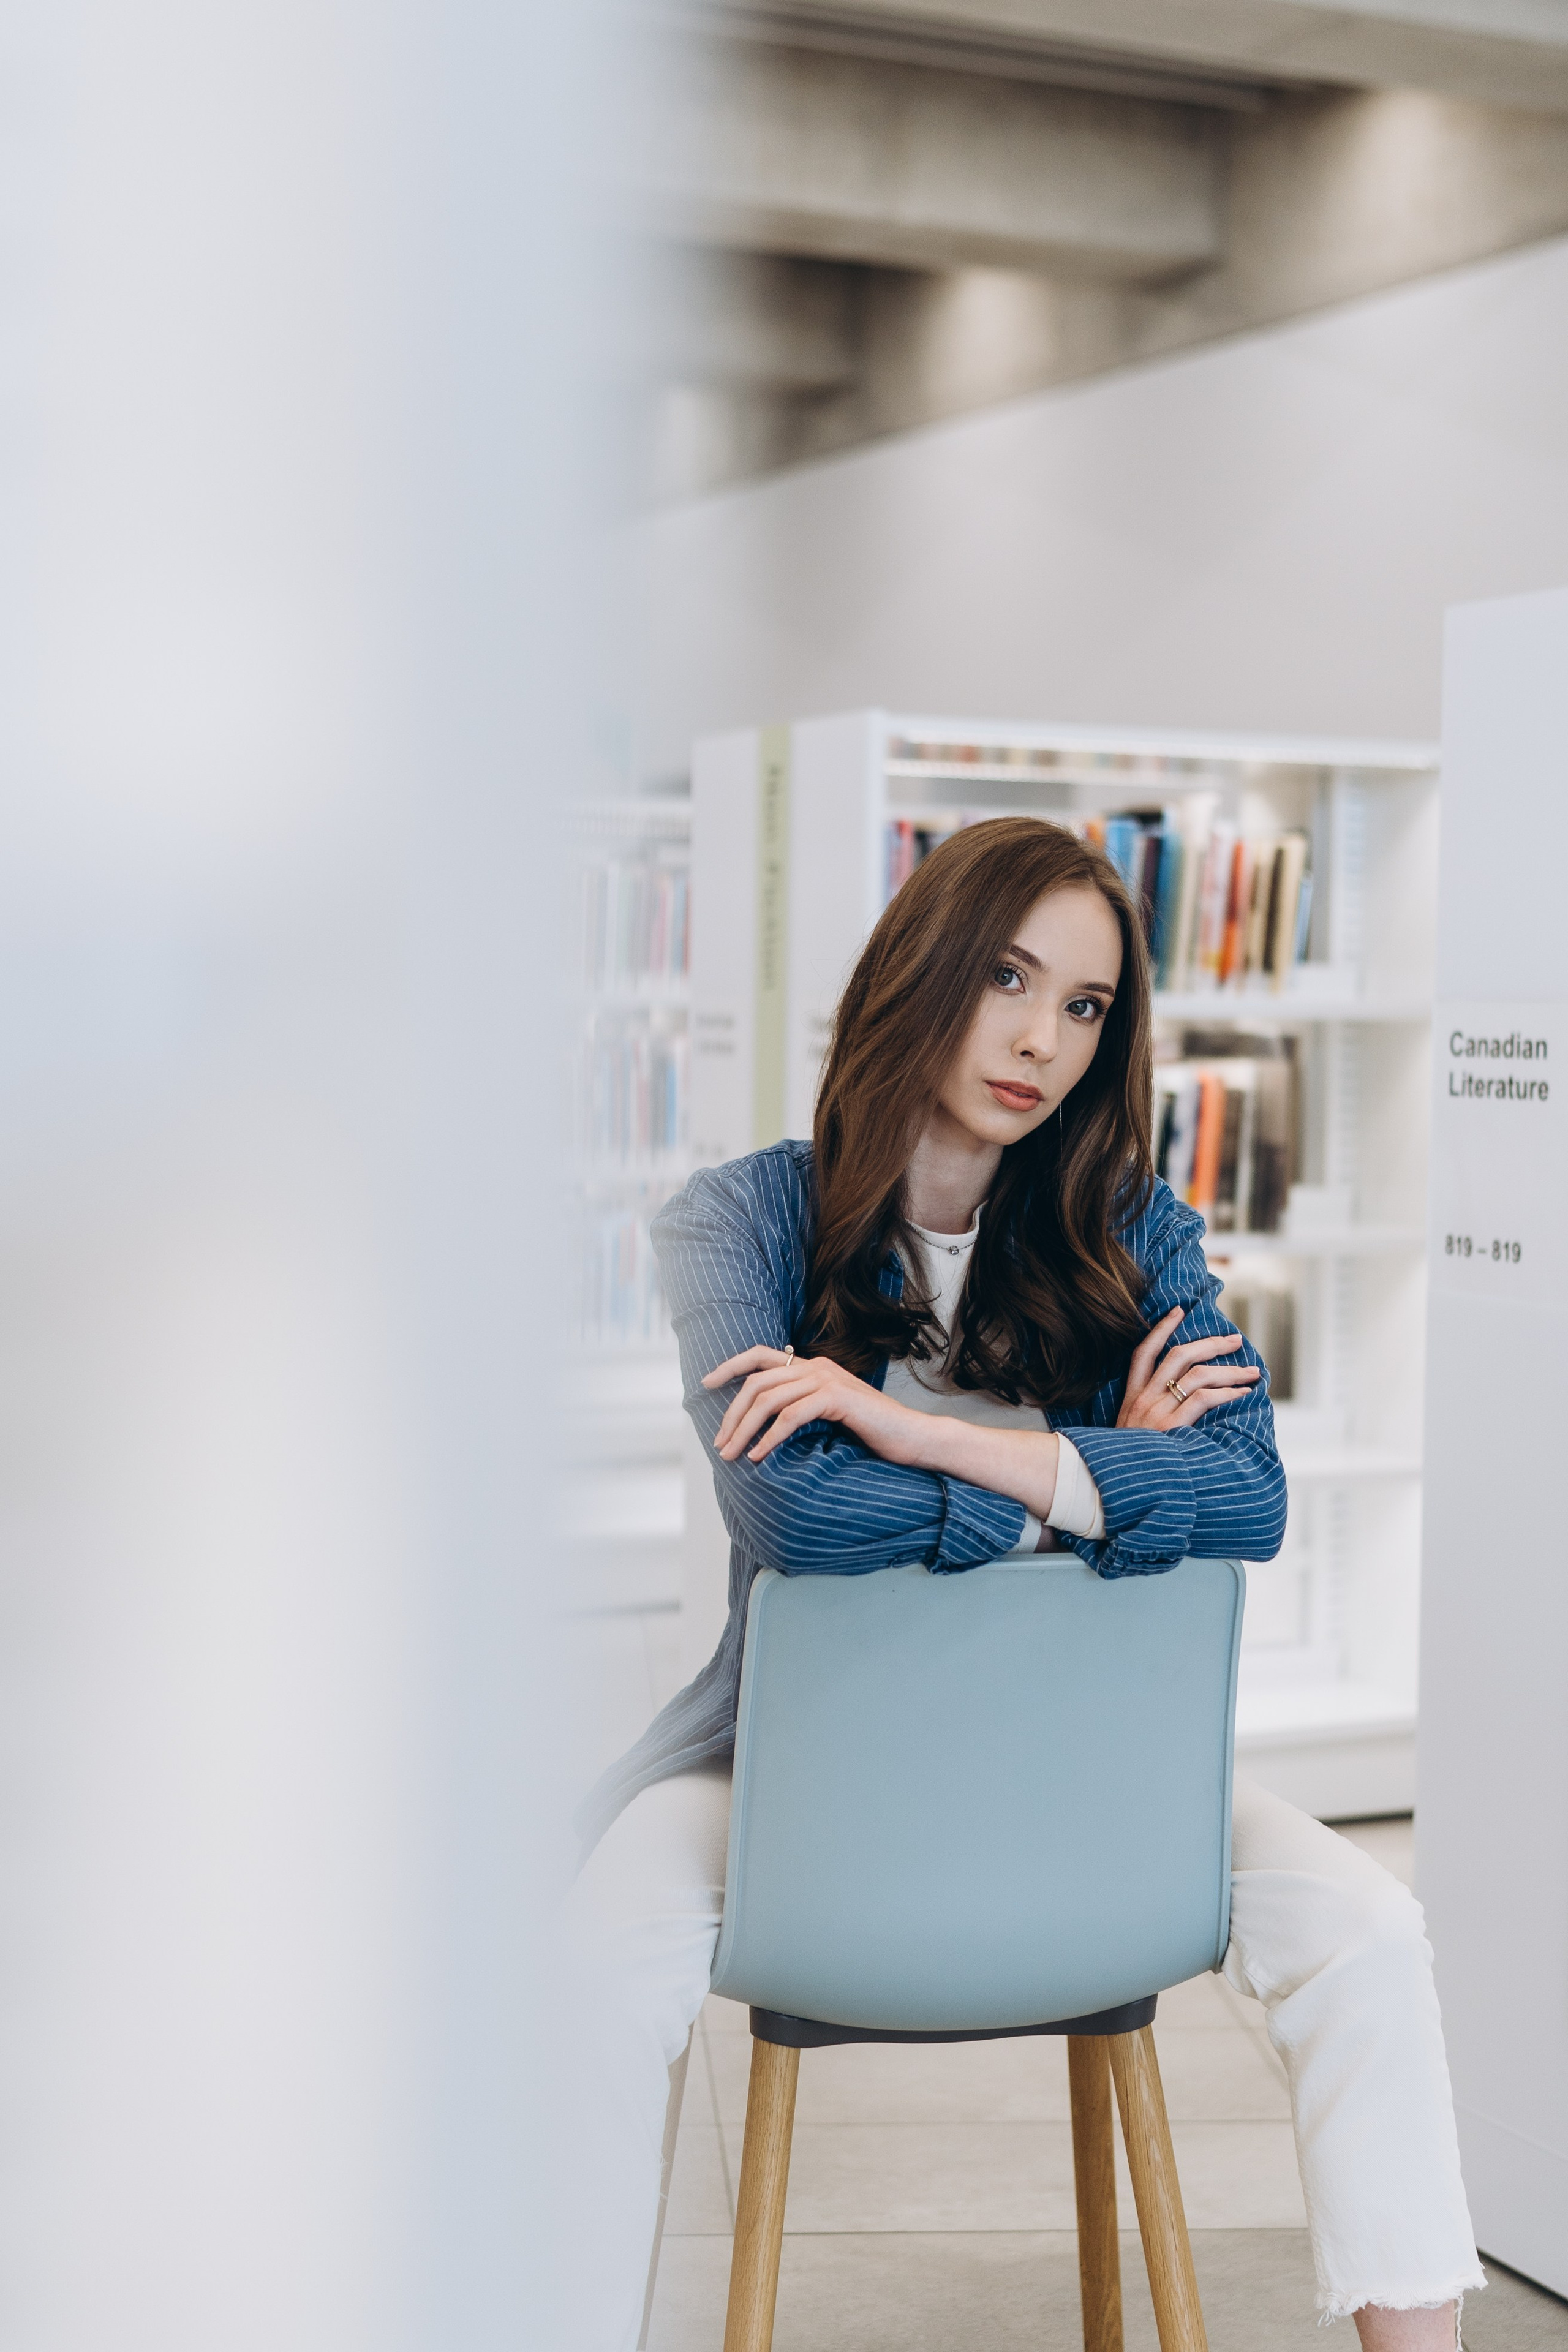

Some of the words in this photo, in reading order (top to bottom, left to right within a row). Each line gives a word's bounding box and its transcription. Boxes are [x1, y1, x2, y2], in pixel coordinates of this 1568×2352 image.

[1449, 1030, 1548, 1060] Canadian
[1449, 1071, 1549, 1101] Literature
[1446, 1234, 1472, 1258] 819
[1491, 1238, 1521, 1264] 819
